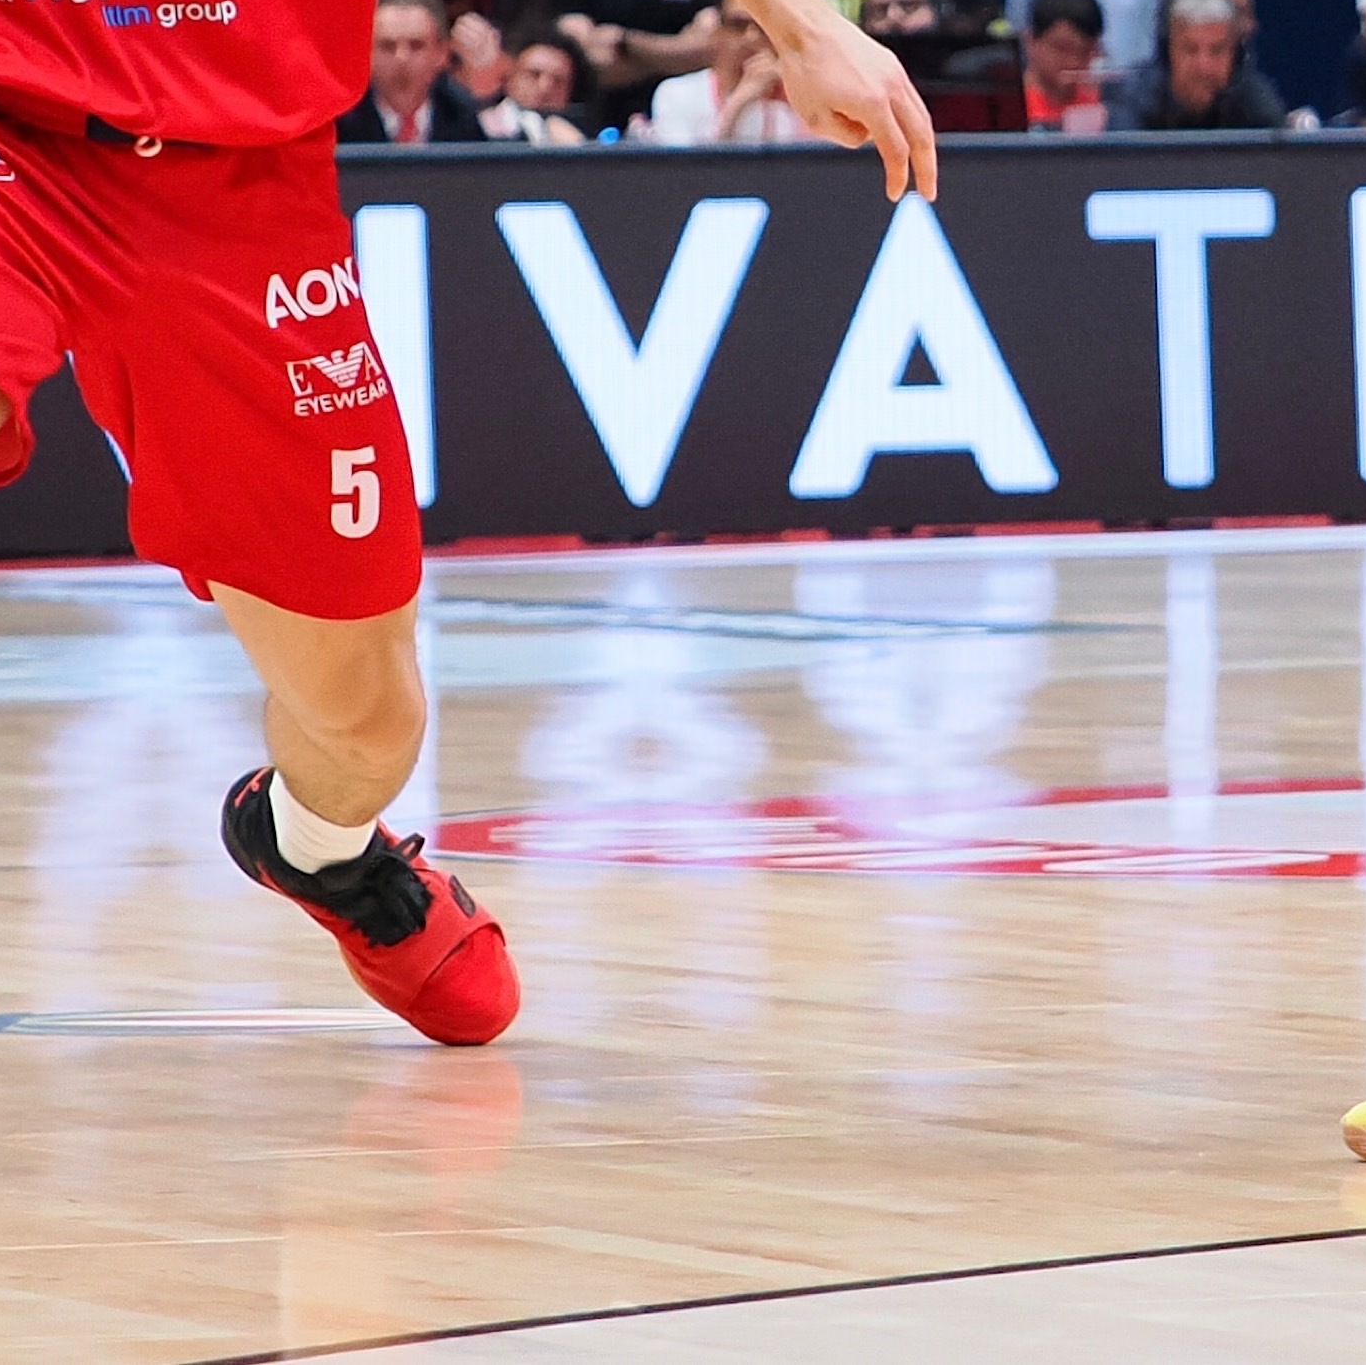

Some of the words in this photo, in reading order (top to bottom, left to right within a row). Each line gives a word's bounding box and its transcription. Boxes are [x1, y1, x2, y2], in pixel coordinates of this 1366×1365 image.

[156, 0, 238, 29] group
[265, 256, 362, 330] AON
[293, 379, 389, 417] EYEWEAR
[330, 445, 381, 539] 5
